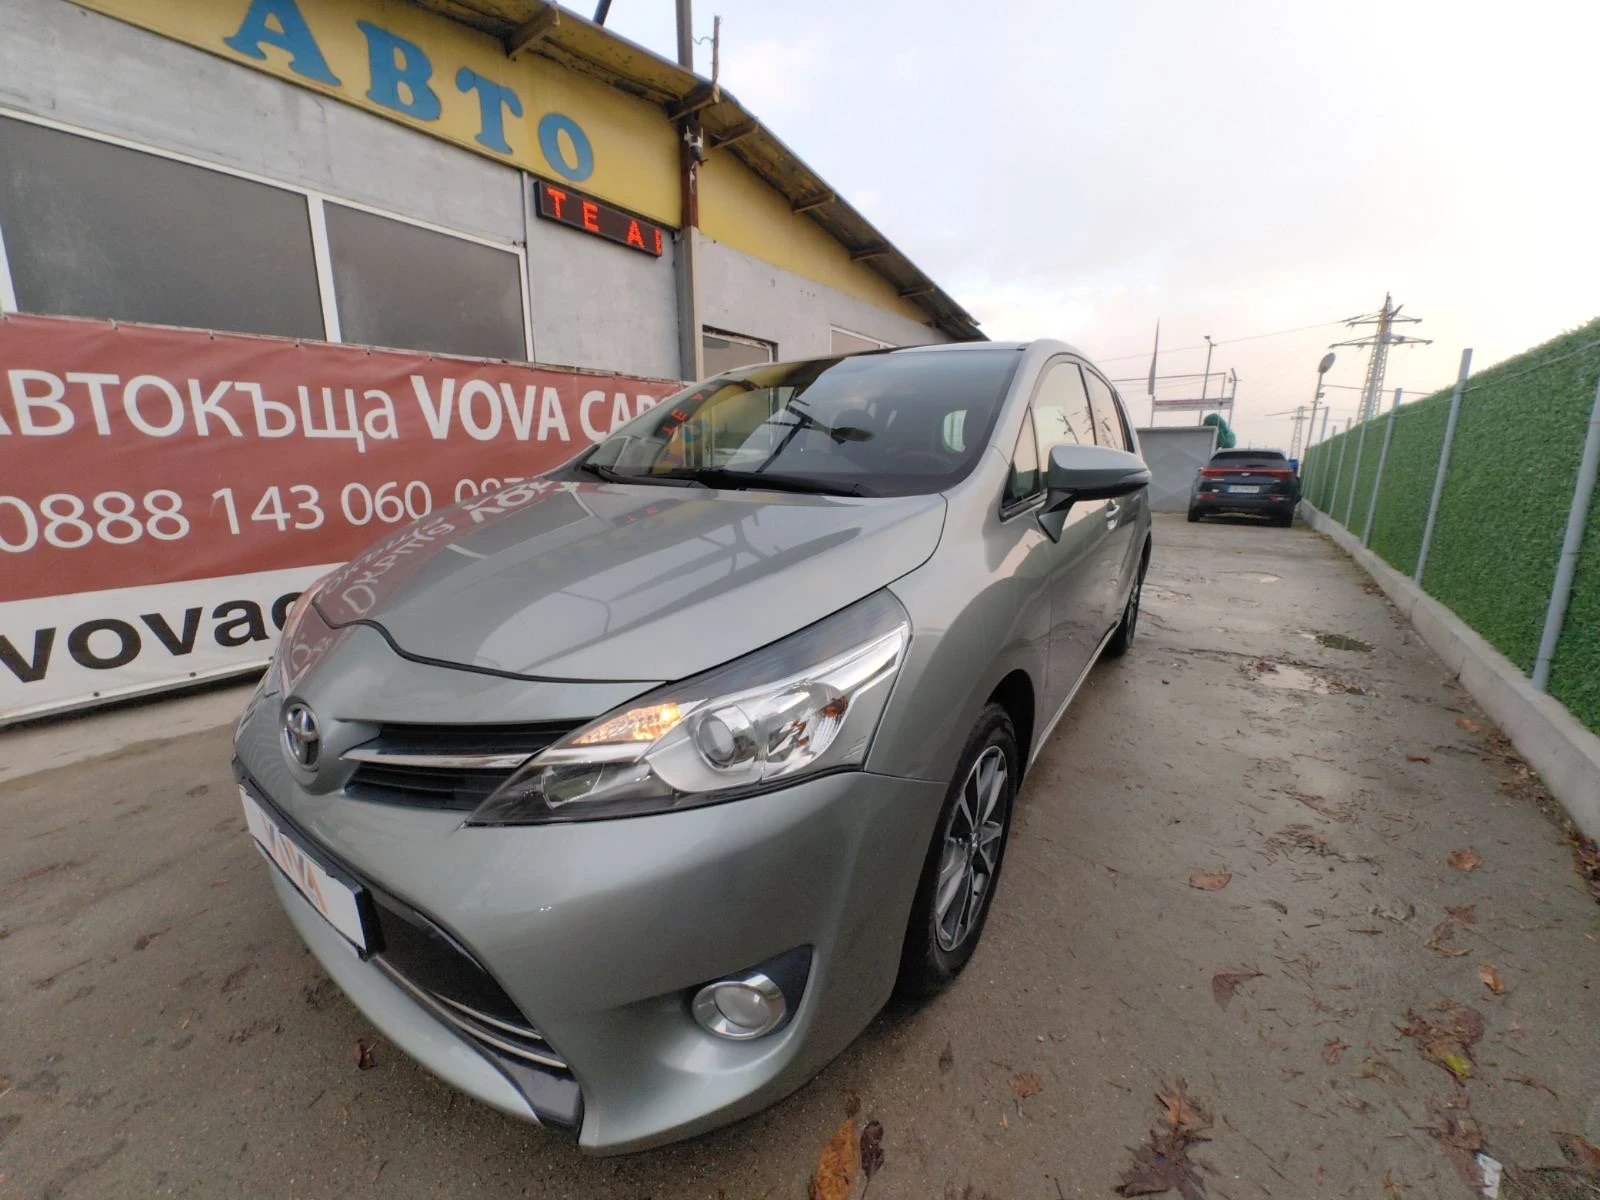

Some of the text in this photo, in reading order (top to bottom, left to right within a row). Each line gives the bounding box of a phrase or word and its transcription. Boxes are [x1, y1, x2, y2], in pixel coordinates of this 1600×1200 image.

[223, 0, 594, 182] АВТО
[410, 374, 571, 442] VOVA
[212, 484, 325, 535] 143
[341, 480, 432, 526] 060
